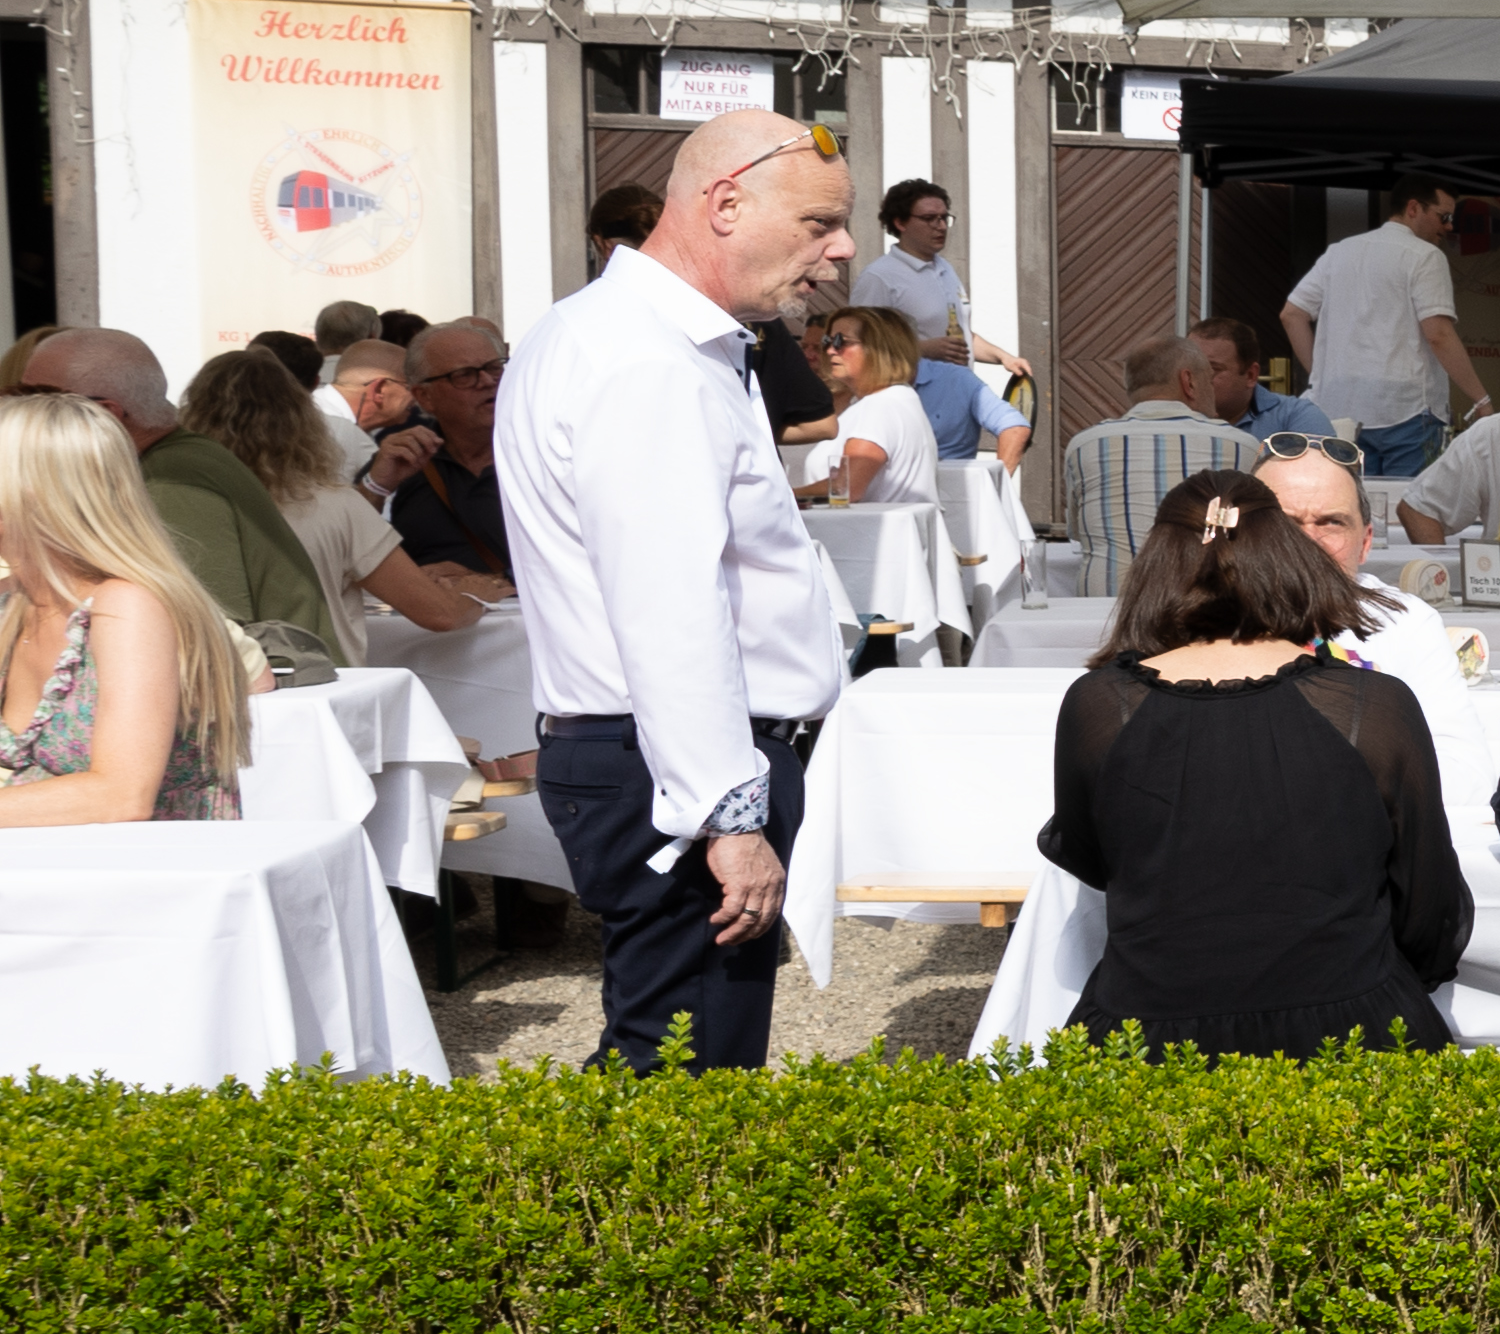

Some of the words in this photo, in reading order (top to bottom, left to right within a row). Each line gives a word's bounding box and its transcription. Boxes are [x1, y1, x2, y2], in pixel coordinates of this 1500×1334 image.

[254, 10, 409, 44] Herzlich
[220, 53, 443, 91] Willkommen
[680, 60, 751, 76] ZUGANG
[684, 80, 715, 93] NUR
[721, 80, 748, 95] FÜR
[1132, 89, 1158, 100] KEIN
[322, 129, 381, 152] EHRLICH
[251, 165, 277, 241] NACHHALTIG
[326, 237, 410, 276] AUTHENTISCH
[218, 331, 239, 342] KG
[1469, 576, 1490, 586] Tisch
[1492, 577, 1500, 586] 10
[1471, 586, 1484, 595] (BG
[1486, 587, 1500, 596] 120)
